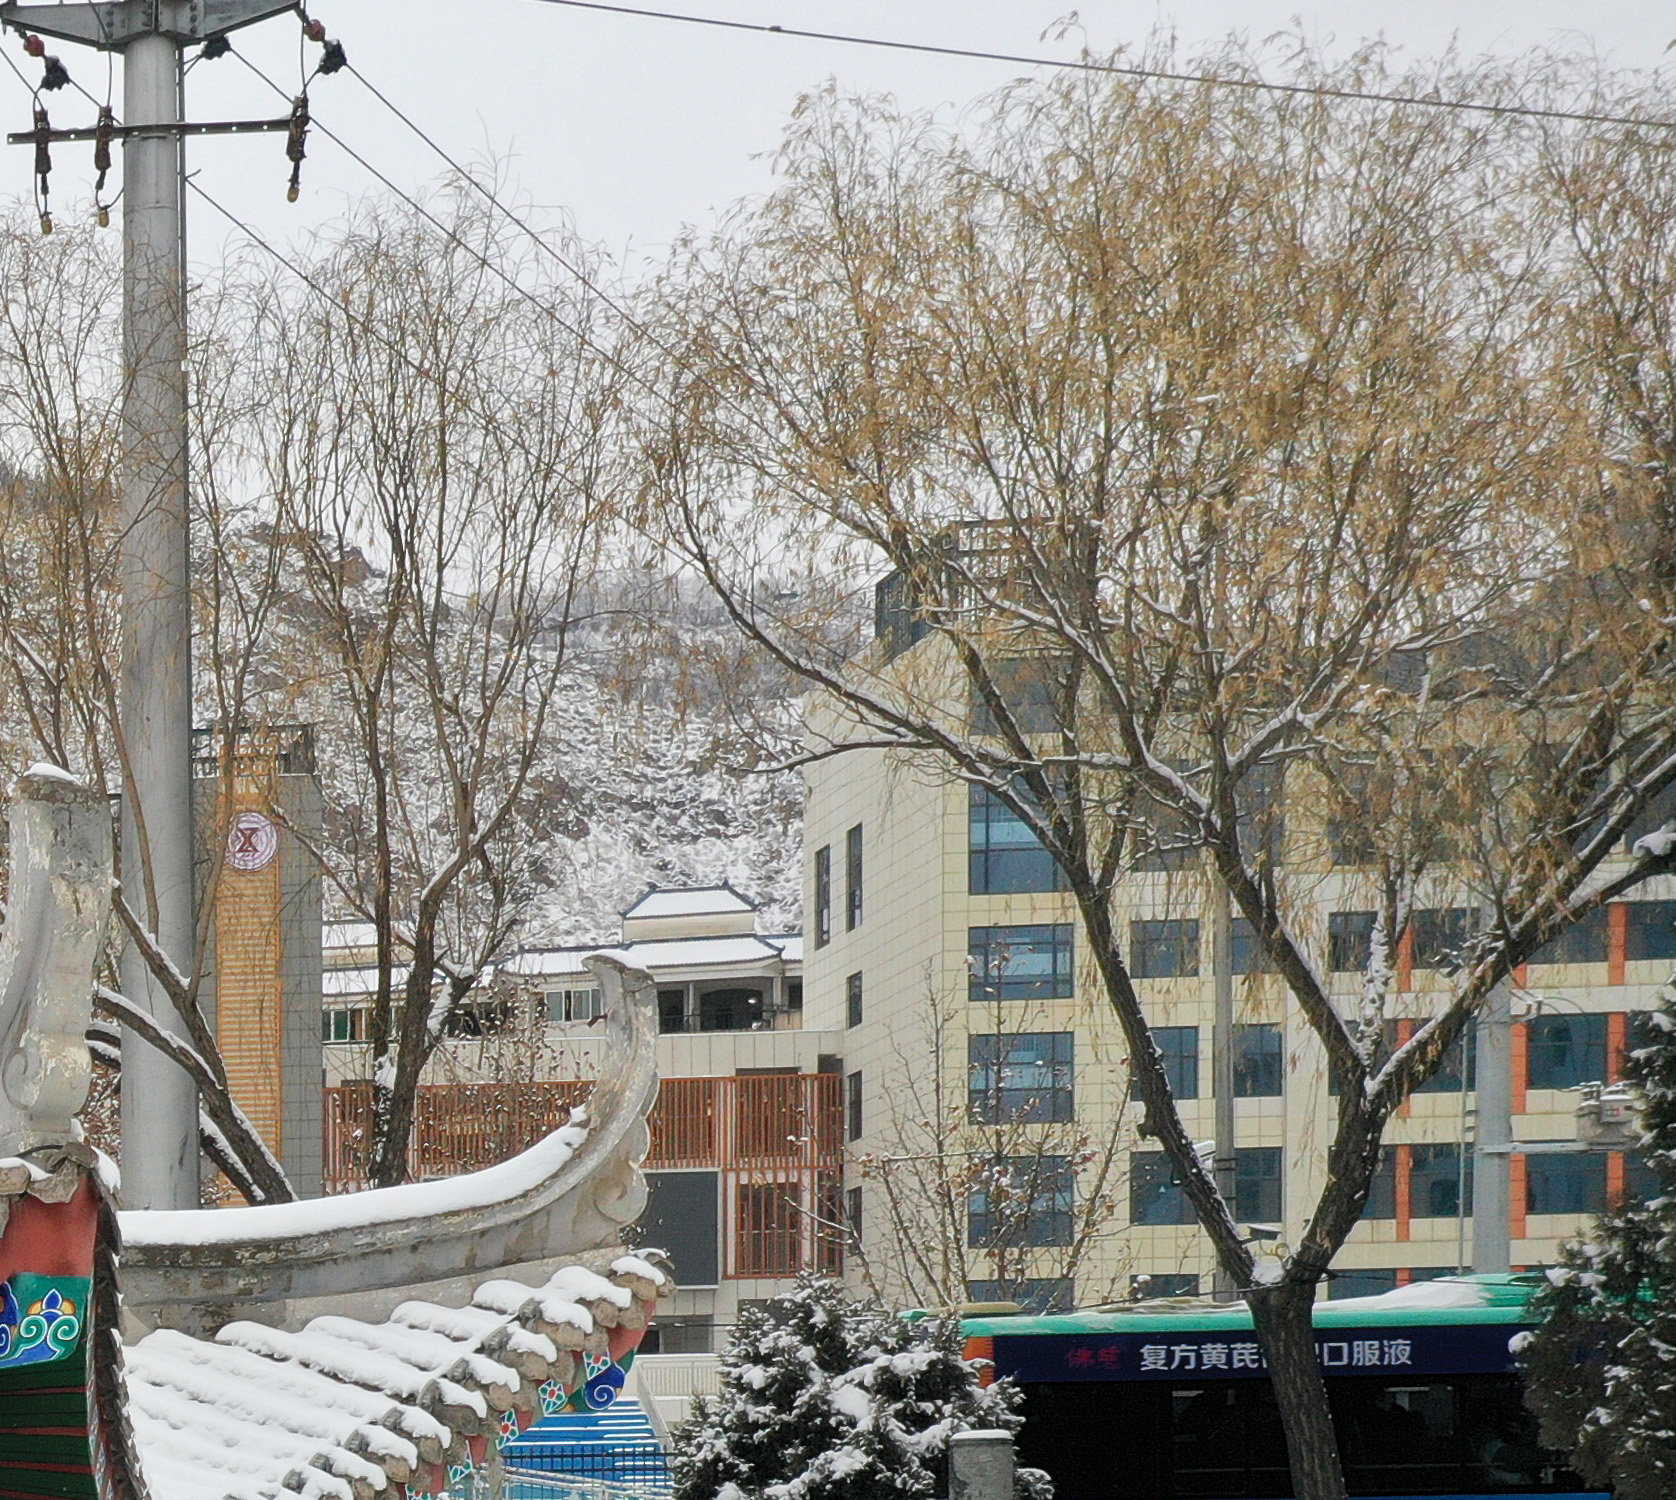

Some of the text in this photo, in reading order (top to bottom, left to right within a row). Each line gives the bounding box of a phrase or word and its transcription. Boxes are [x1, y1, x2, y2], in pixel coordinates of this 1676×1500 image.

[1140, 1339, 1413, 1371] 复方黄芪口服液
